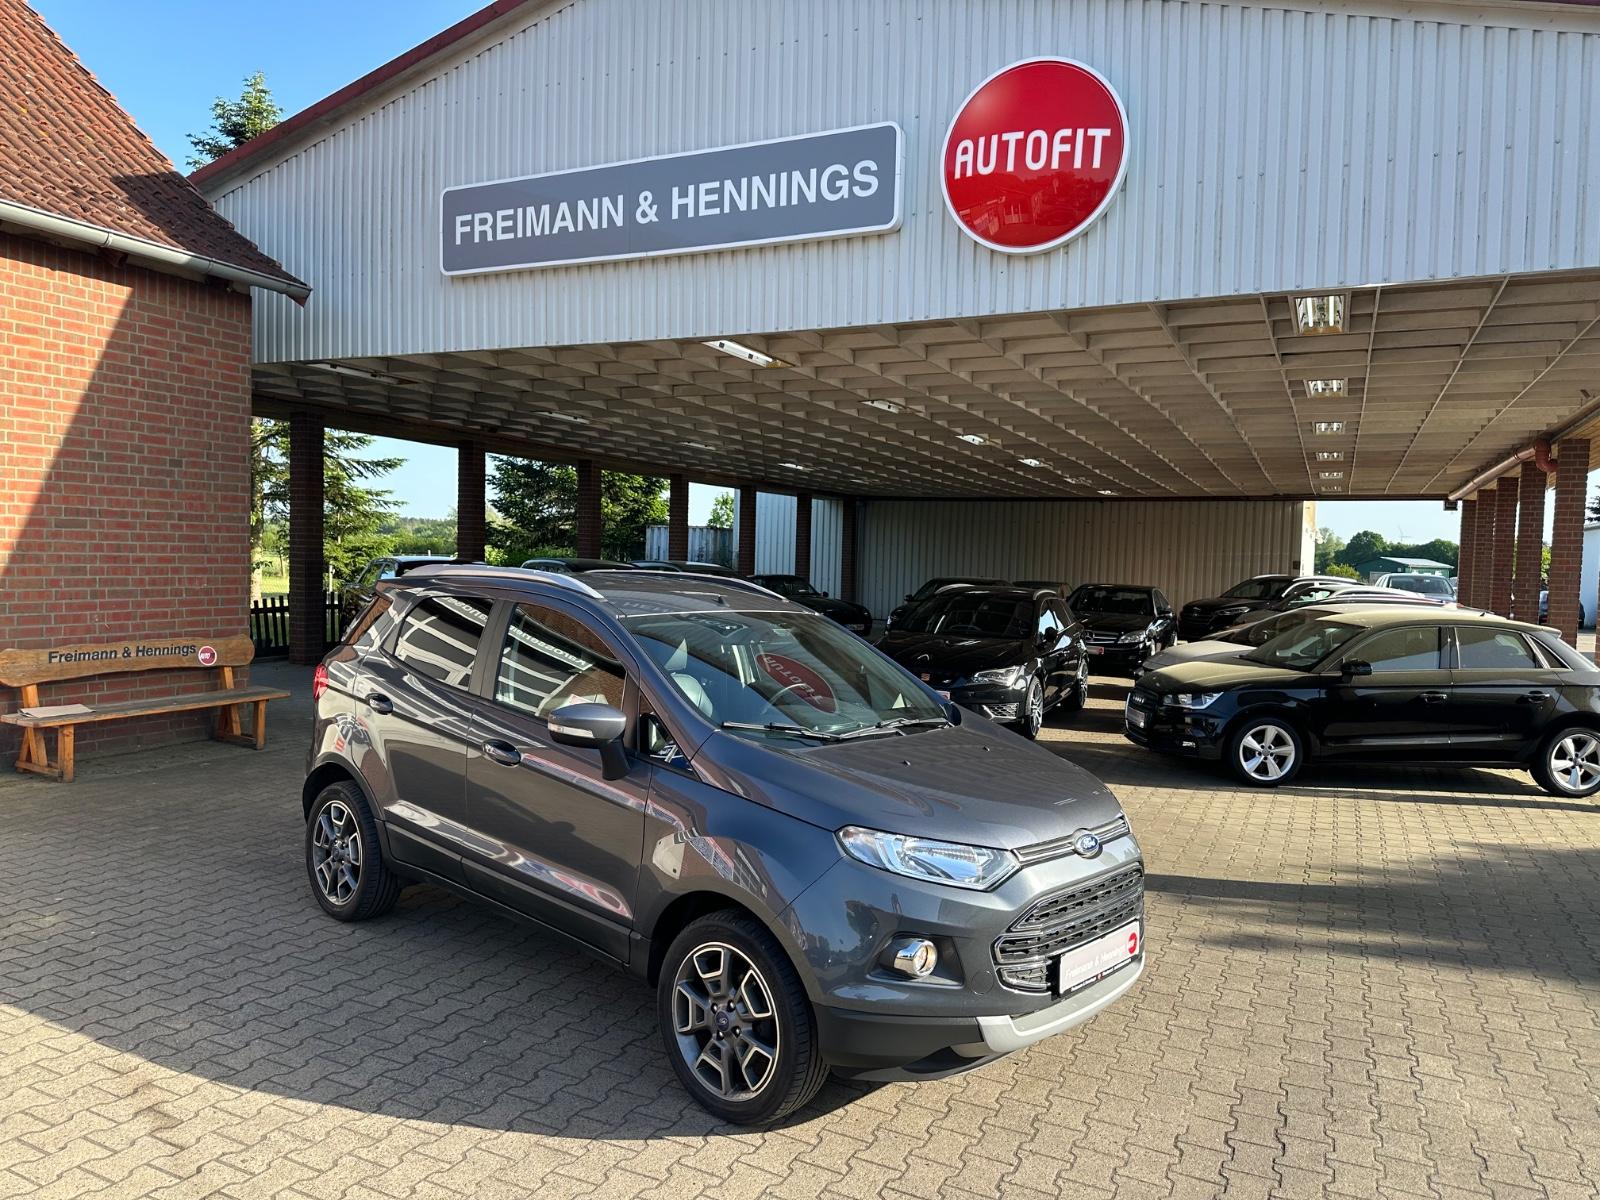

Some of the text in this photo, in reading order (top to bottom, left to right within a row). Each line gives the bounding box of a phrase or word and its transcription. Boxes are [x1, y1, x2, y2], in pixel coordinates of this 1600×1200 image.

[954, 128, 1111, 180] AUTOFIT
[455, 159, 879, 245] FREIMANN & HENNINGS
[48, 650, 117, 664] Freimann
[122, 646, 132, 658] &
[136, 644, 197, 657] Hennings
